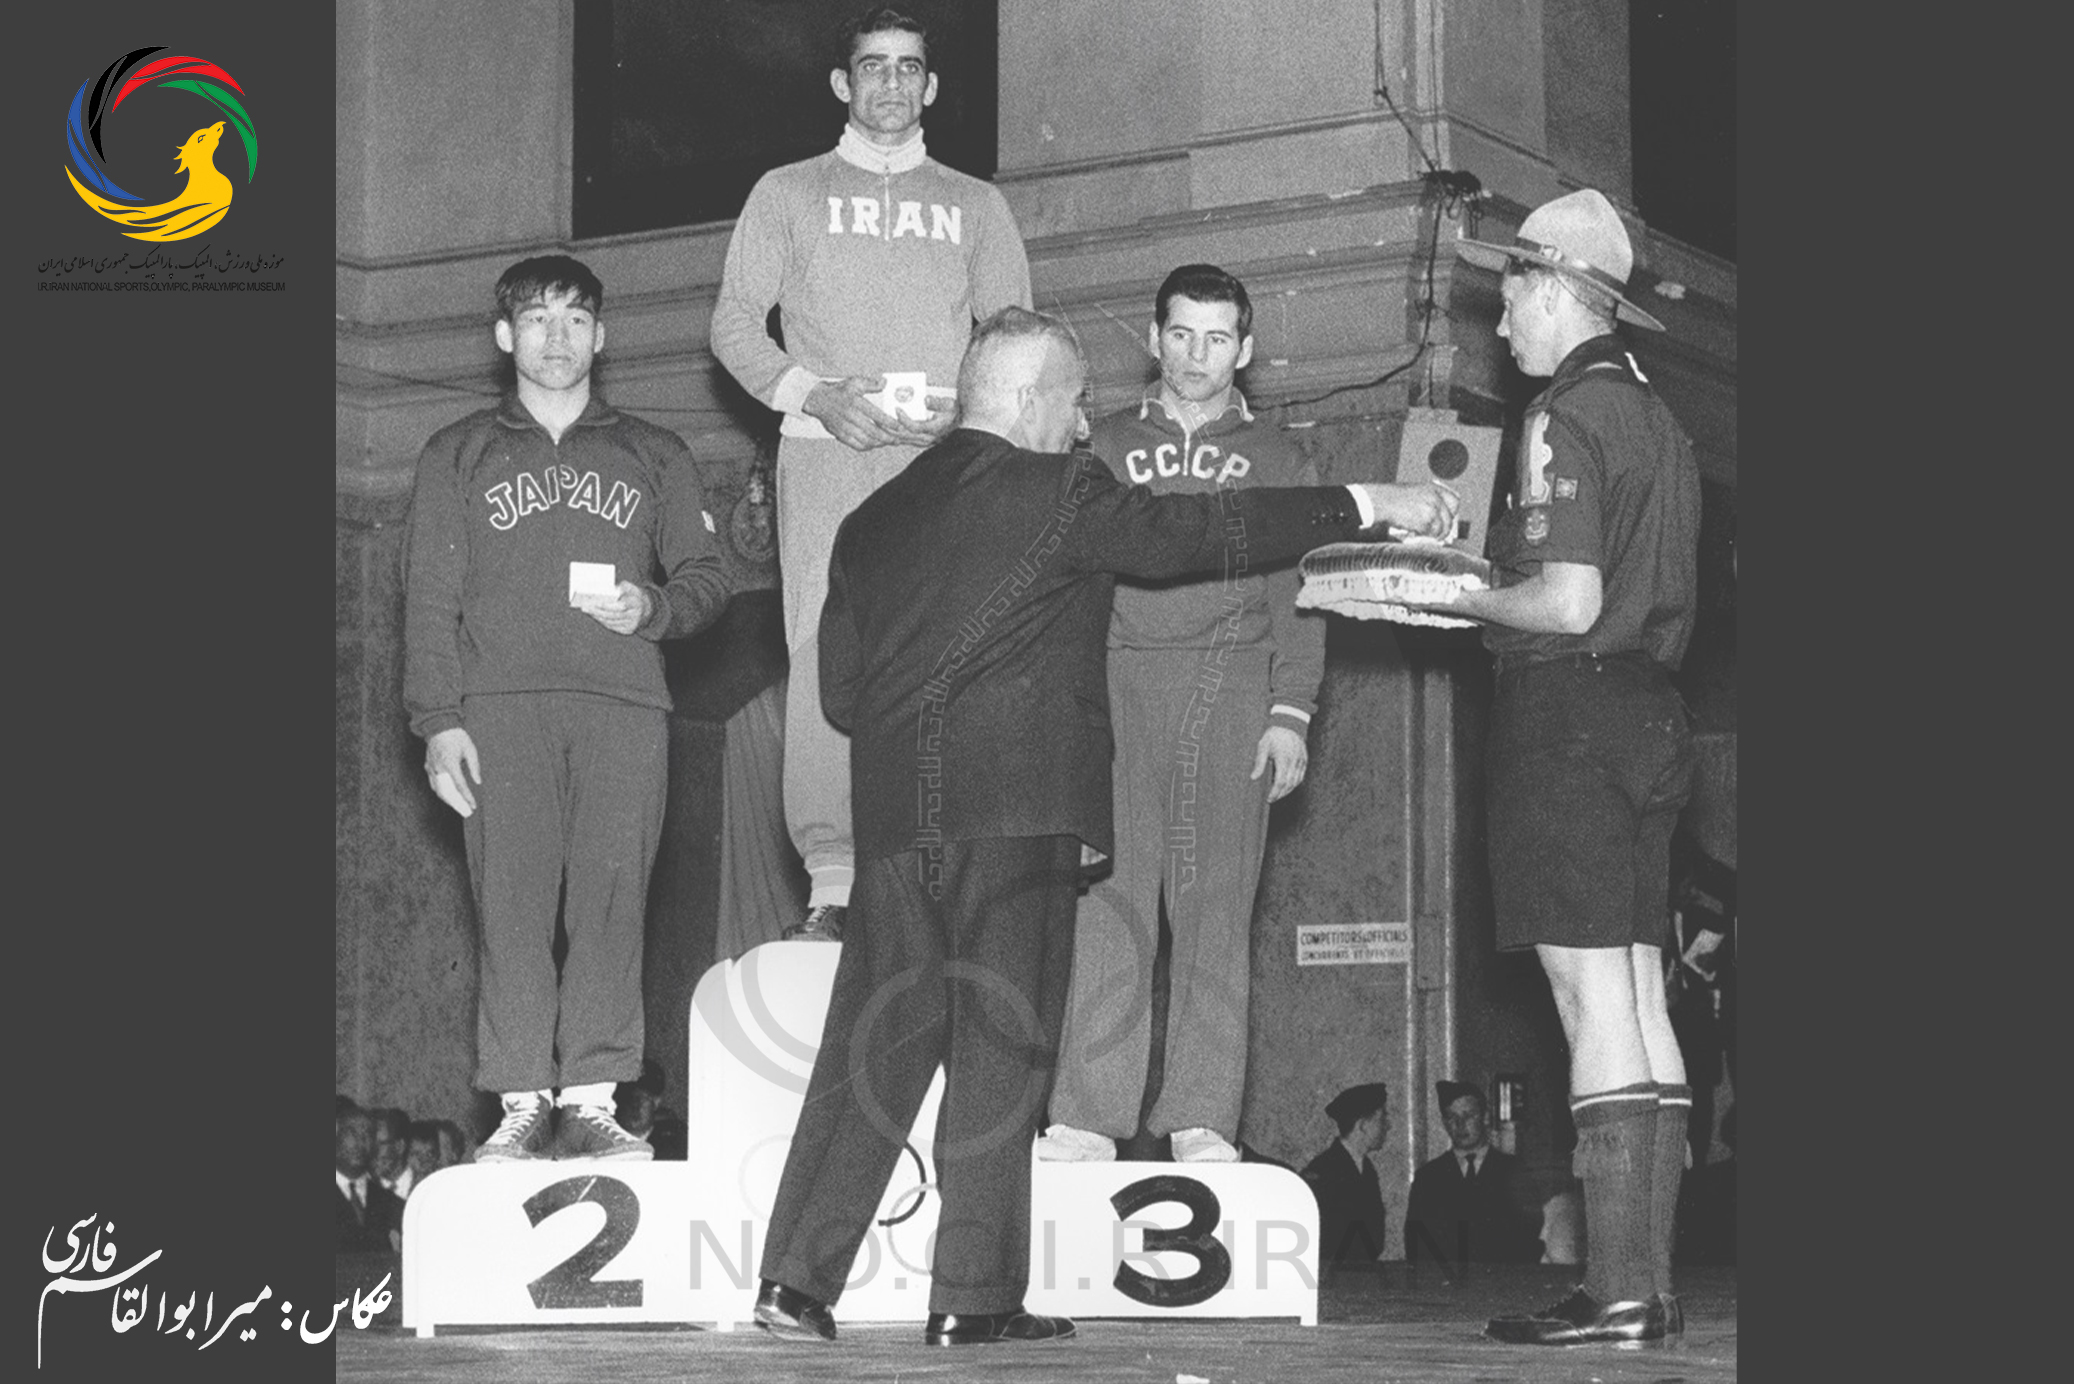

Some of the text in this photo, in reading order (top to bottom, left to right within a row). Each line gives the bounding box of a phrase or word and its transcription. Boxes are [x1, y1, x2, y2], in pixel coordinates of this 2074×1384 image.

[827, 196, 962, 245] IRAN
[485, 464, 641, 530] JAPAN
[522, 1174, 644, 1309] 2
[1109, 1174, 1232, 1308] 3
